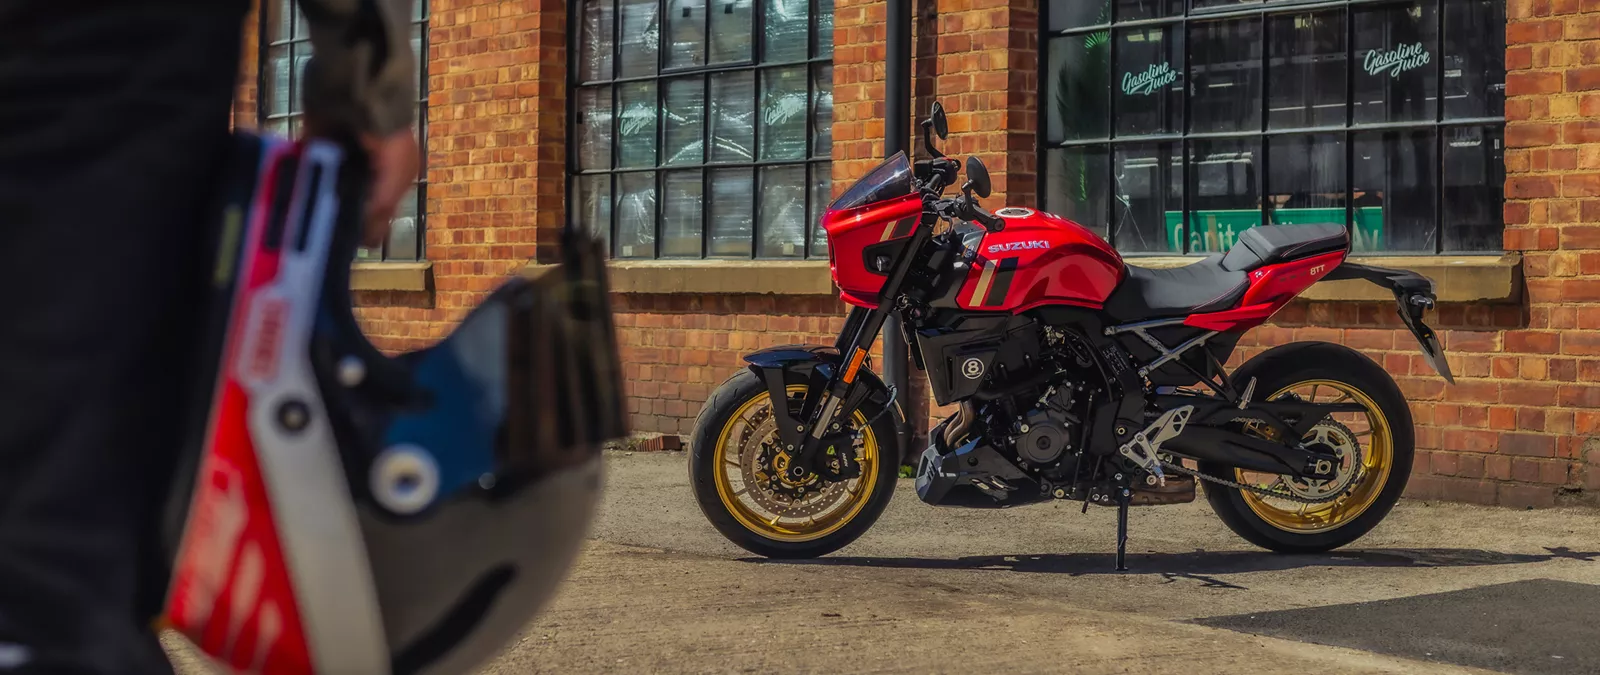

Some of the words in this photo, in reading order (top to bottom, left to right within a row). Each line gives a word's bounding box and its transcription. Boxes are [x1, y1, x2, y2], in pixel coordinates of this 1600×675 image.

[1364, 42, 1422, 75] Gasoline
[1122, 61, 1169, 95] Gasoline
[988, 240, 1050, 253] SUZUKI
[1310, 264, 1325, 276] 8TT
[967, 360, 979, 373] 8
